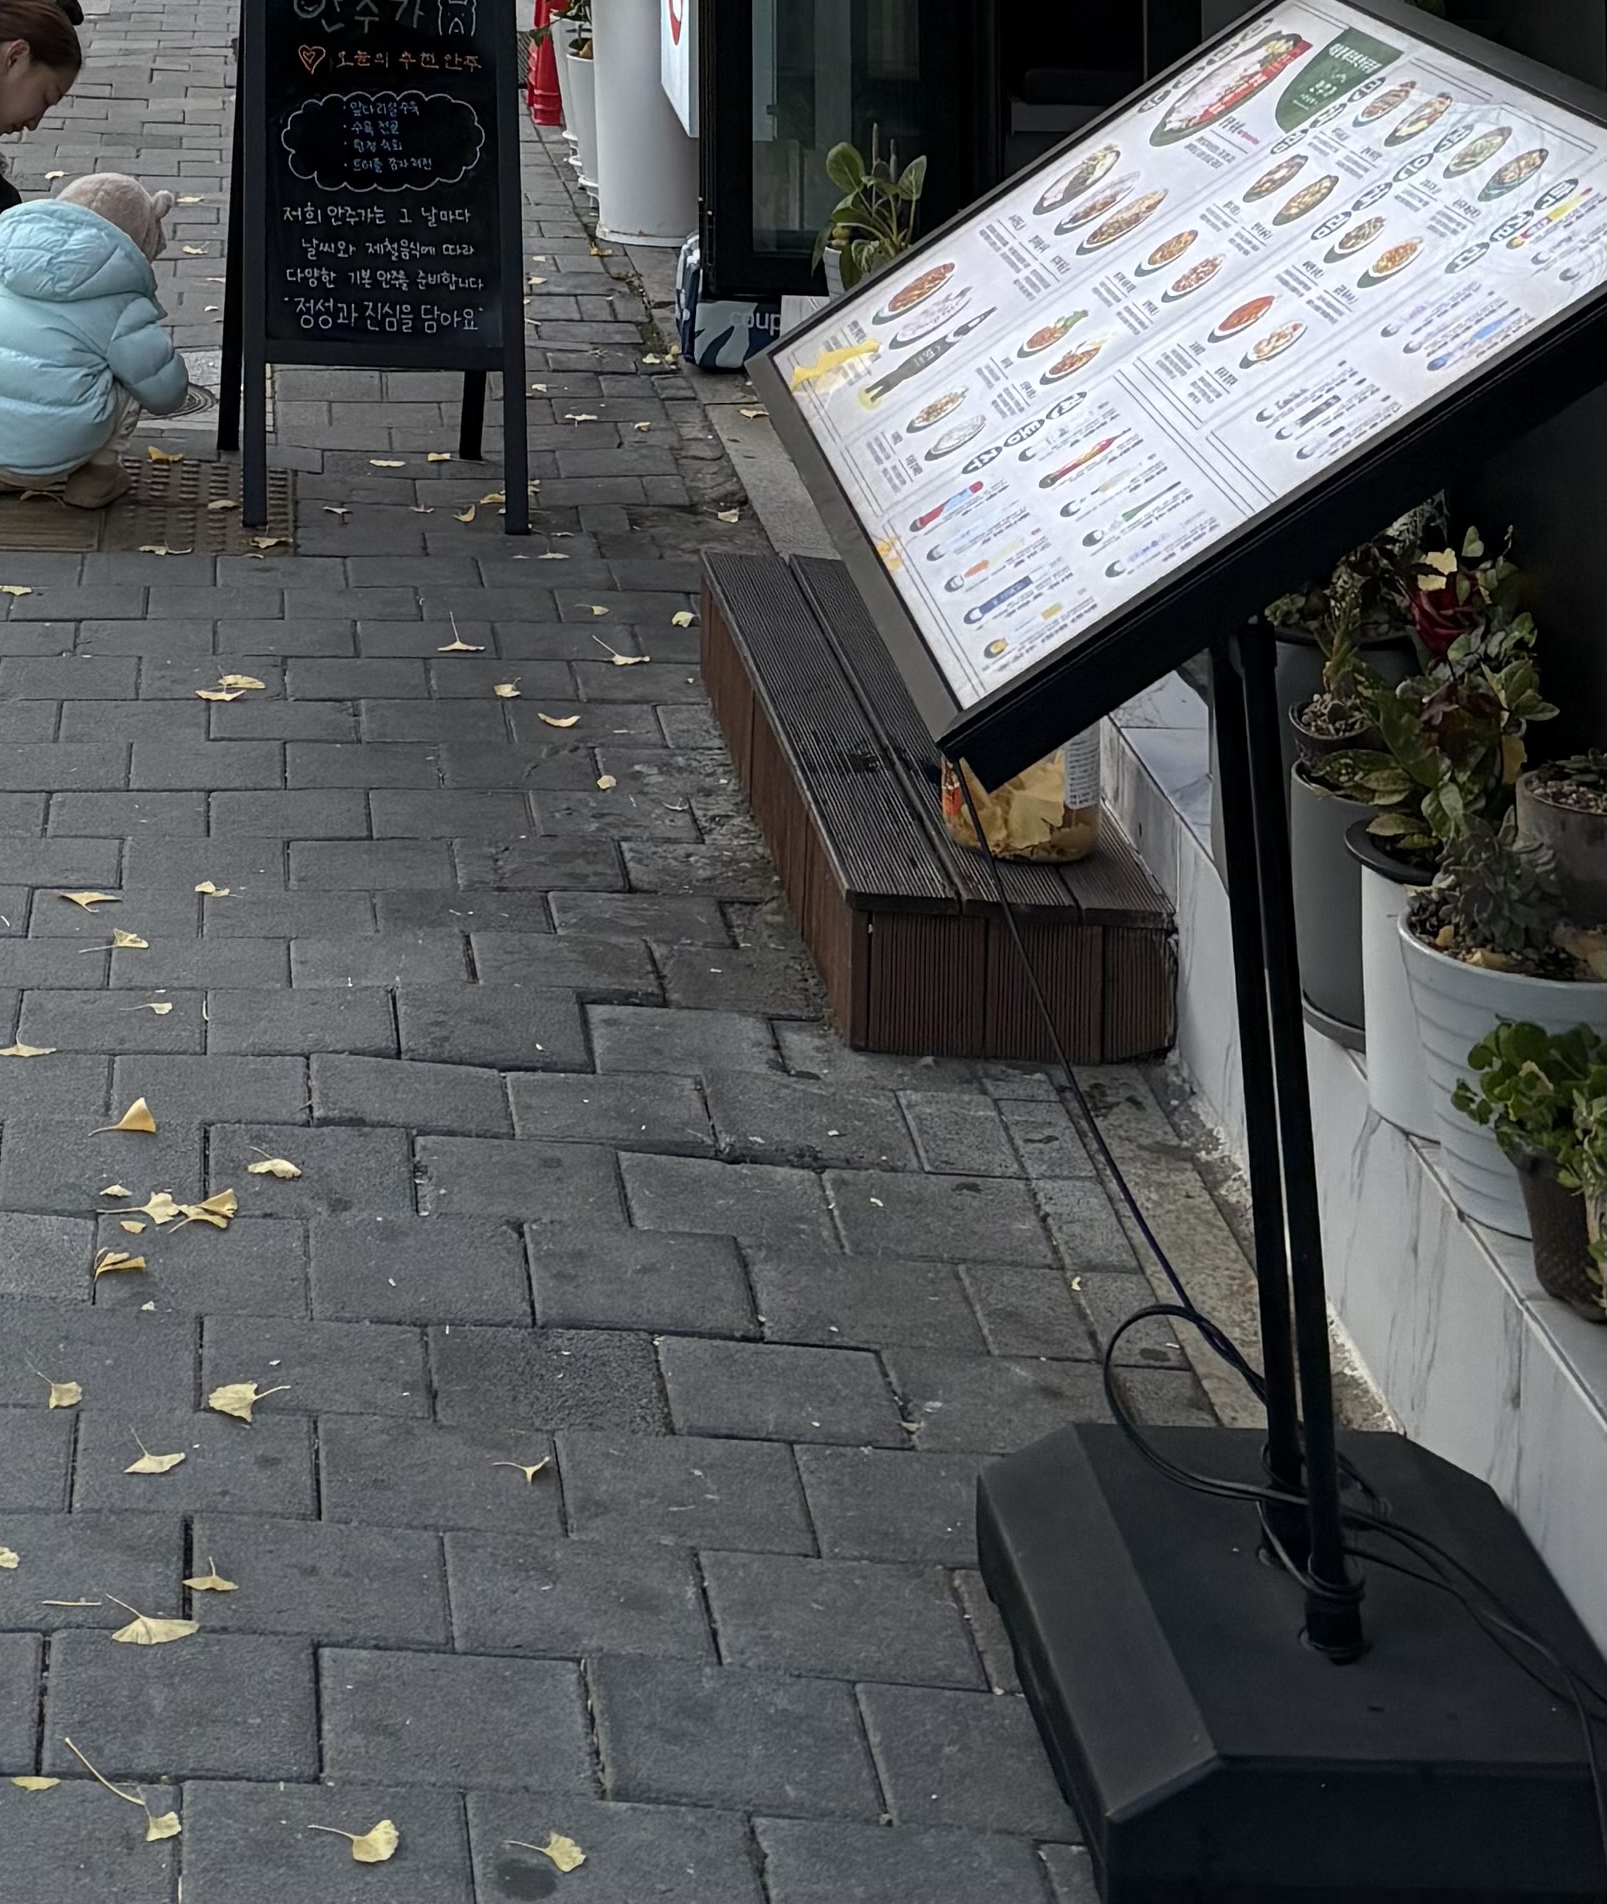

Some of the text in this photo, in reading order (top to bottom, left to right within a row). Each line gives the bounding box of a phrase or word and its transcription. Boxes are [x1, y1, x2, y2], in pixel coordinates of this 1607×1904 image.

[336, 50, 482, 73] 오늘의 추천 안주
[283, 202, 471, 227] 저희 안주가는 그 날마다
[302, 238, 476, 261] 날씨와 제철음식에 따라
[286, 267, 484, 291] 다양한 기본 안주를 준비합니다
[363, 301, 414, 333] 진심을
